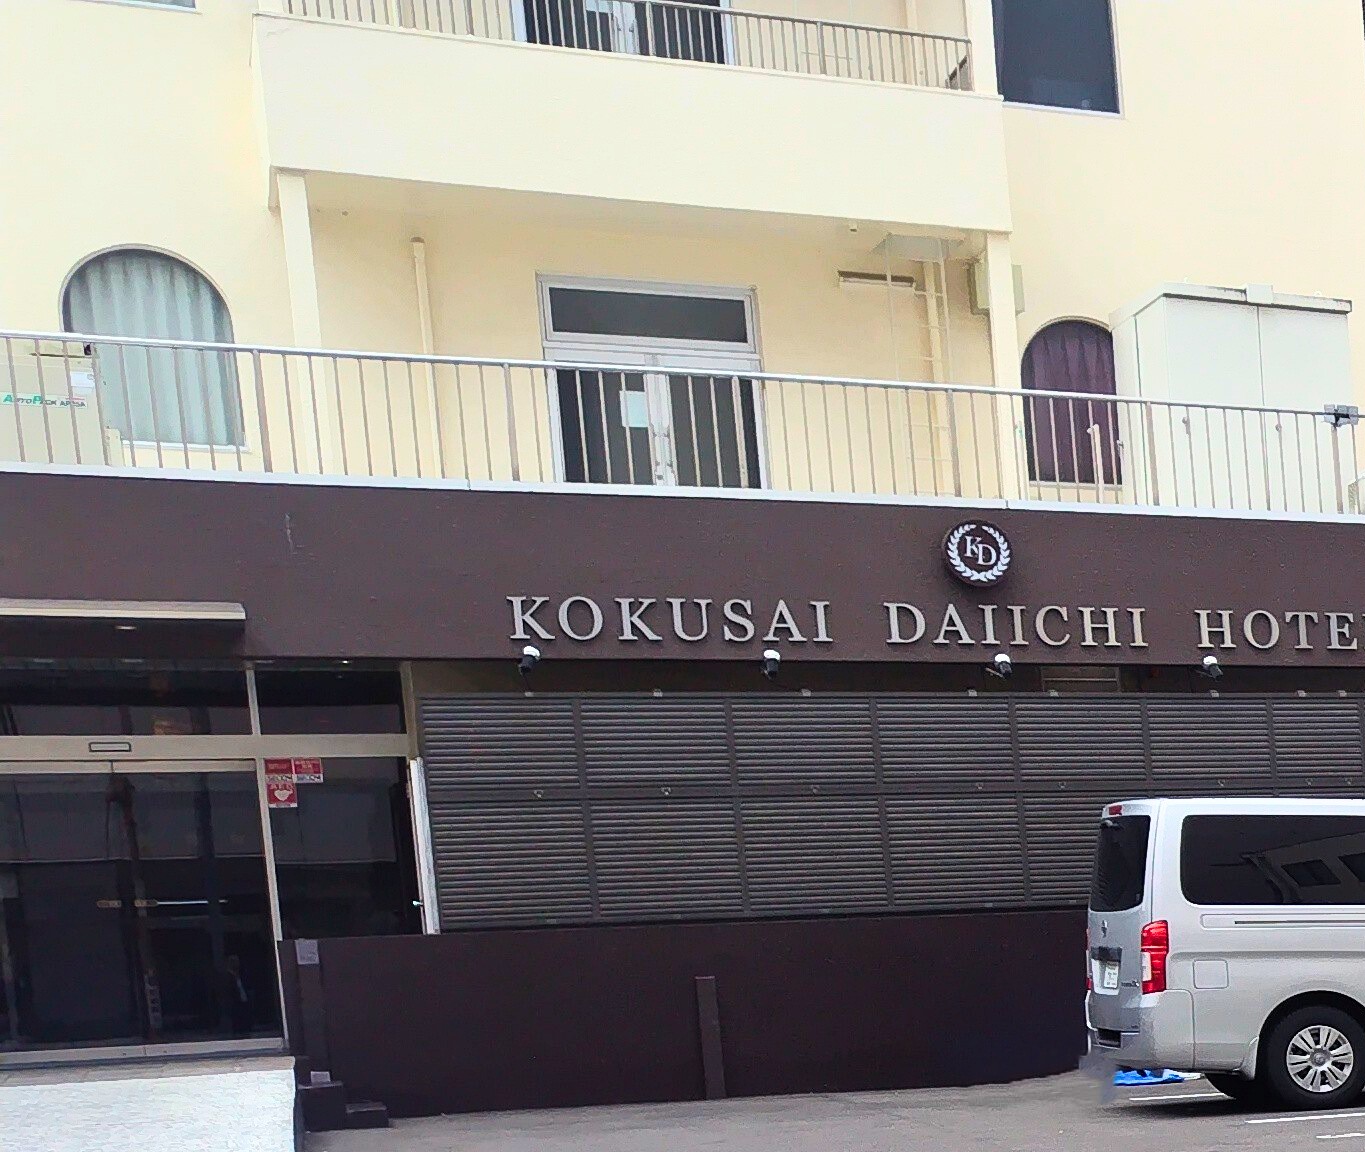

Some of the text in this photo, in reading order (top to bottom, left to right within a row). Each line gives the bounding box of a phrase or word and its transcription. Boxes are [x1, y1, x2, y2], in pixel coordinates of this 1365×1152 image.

[964, 535, 997, 566] KD
[506, 595, 834, 643] KOKUSAI
[883, 601, 1149, 648] DAIICHI
